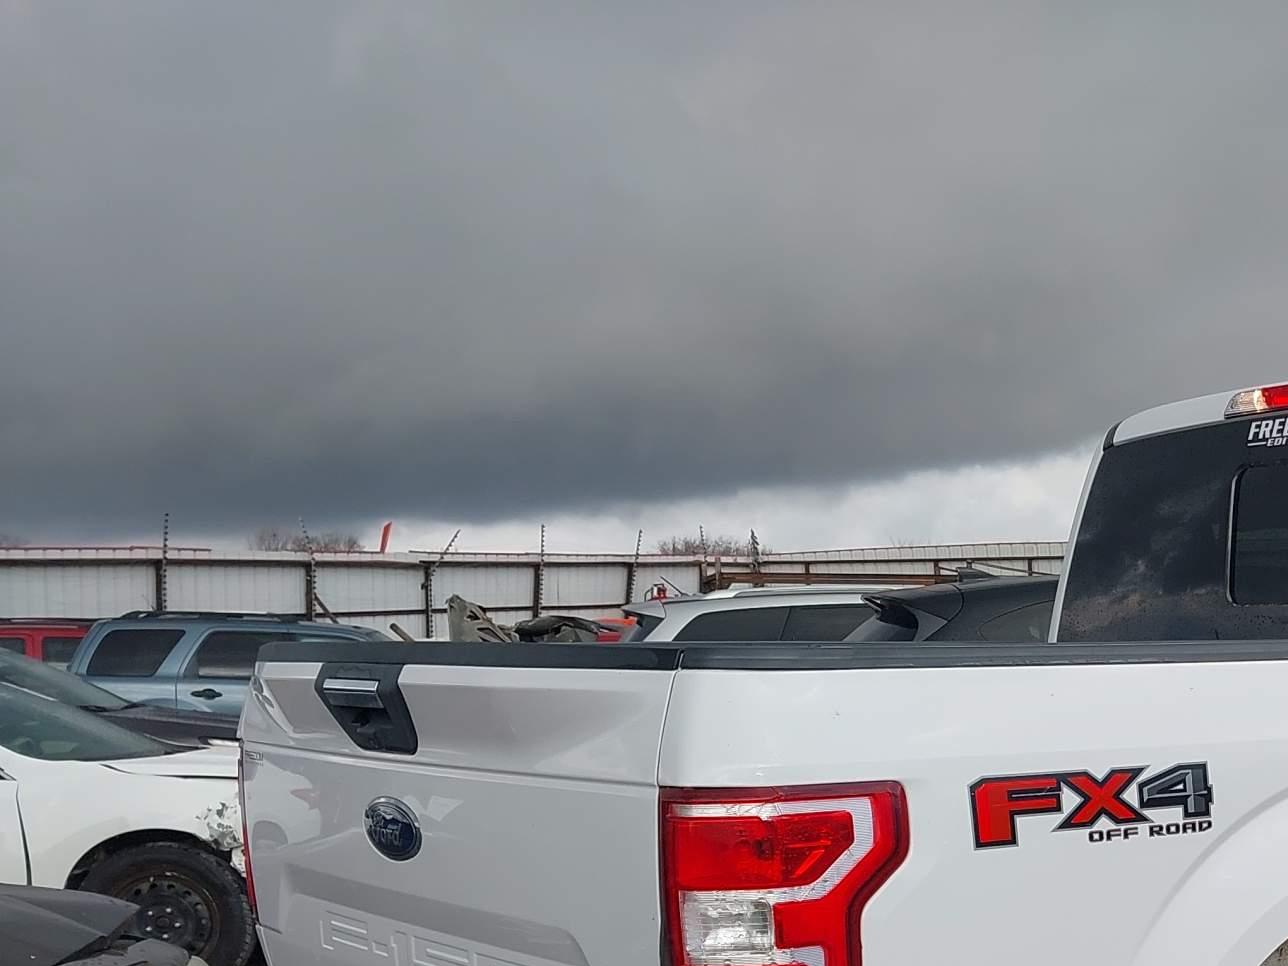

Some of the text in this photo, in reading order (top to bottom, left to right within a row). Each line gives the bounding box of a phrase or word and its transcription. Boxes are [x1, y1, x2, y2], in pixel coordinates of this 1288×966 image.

[967, 761, 1214, 851] FX4
[1088, 819, 1213, 843] OFF ROAD
